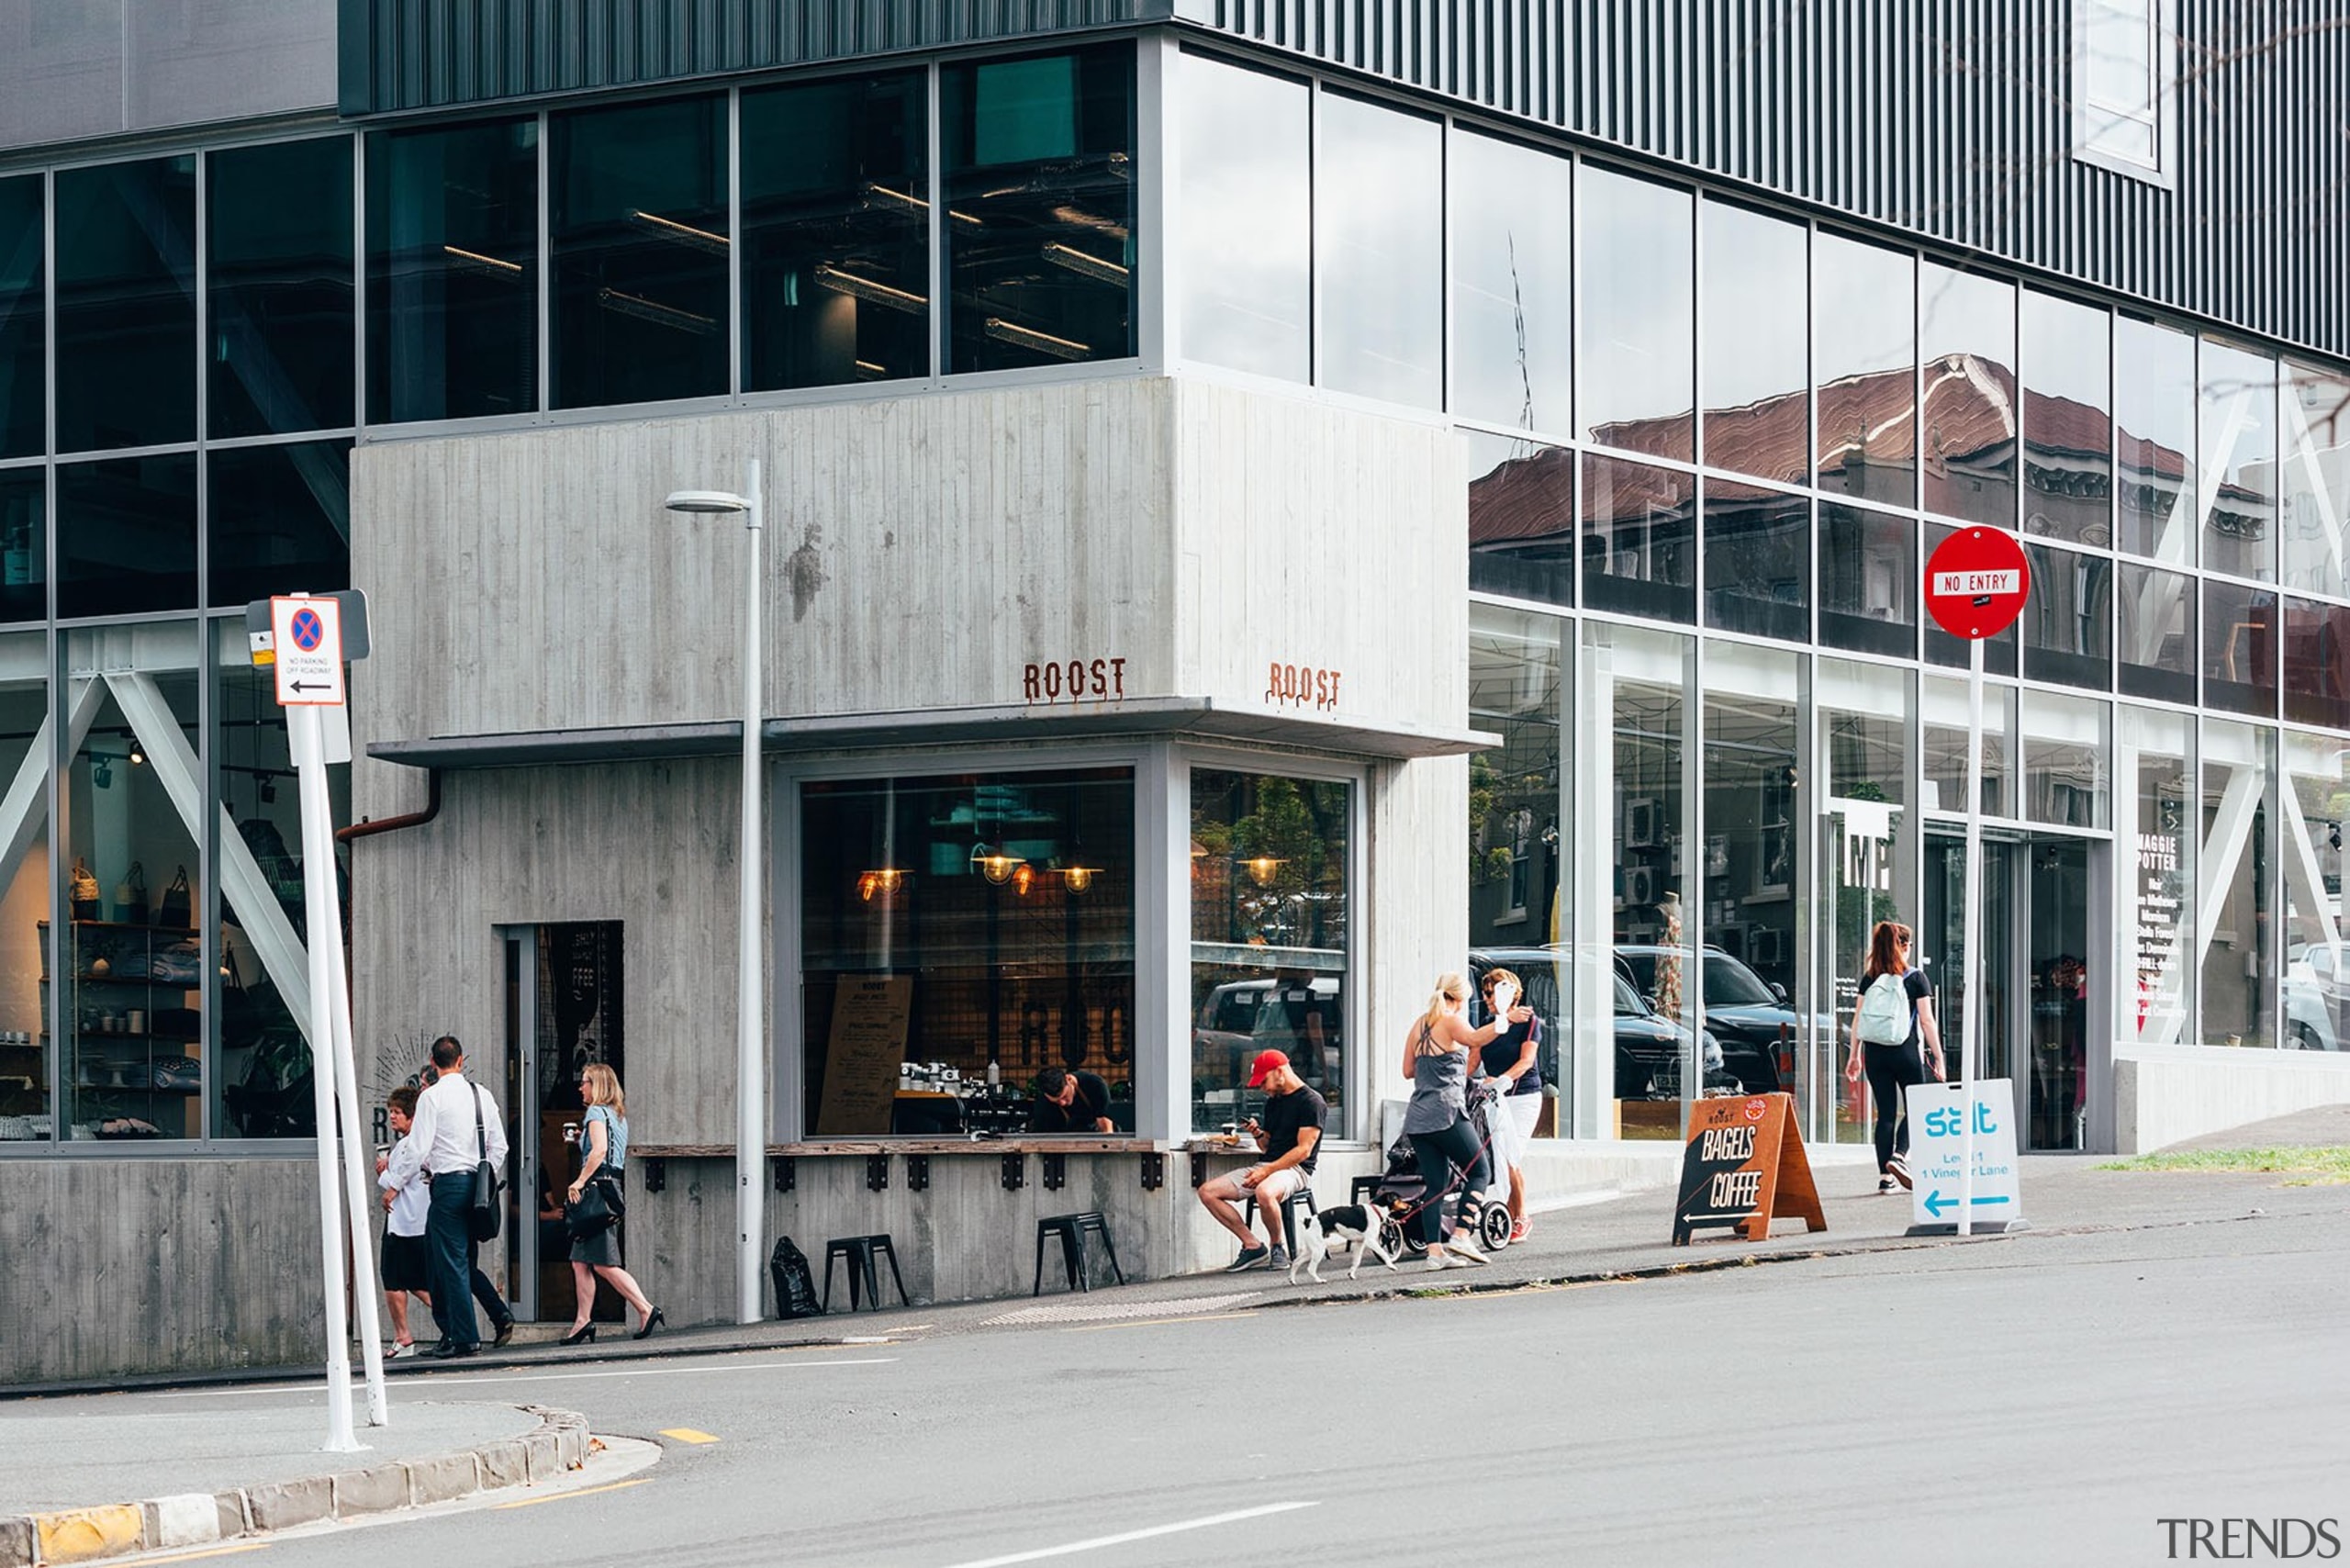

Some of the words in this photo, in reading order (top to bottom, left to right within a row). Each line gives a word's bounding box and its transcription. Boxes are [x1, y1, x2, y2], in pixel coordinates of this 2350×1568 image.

[1944, 576, 1961, 592] NO
[1969, 574, 2008, 591] ENTRY
[300, 657, 329, 666] PARKING
[1024, 658, 1126, 700] ROOST
[1270, 662, 1341, 706] ROOST
[2136, 850, 2177, 871] POTTER
[1708, 1114, 1734, 1125] ROOST
[1701, 1126, 1757, 1162] BAGELS
[1943, 1152, 1975, 1164] Lel
[1977, 1151, 1984, 1162] 1
[1921, 1170, 1928, 1179] 1
[1930, 1168, 1975, 1180] Viner
[1979, 1165, 2009, 1177] Lane
[1709, 1170, 1763, 1208] COFFEE
